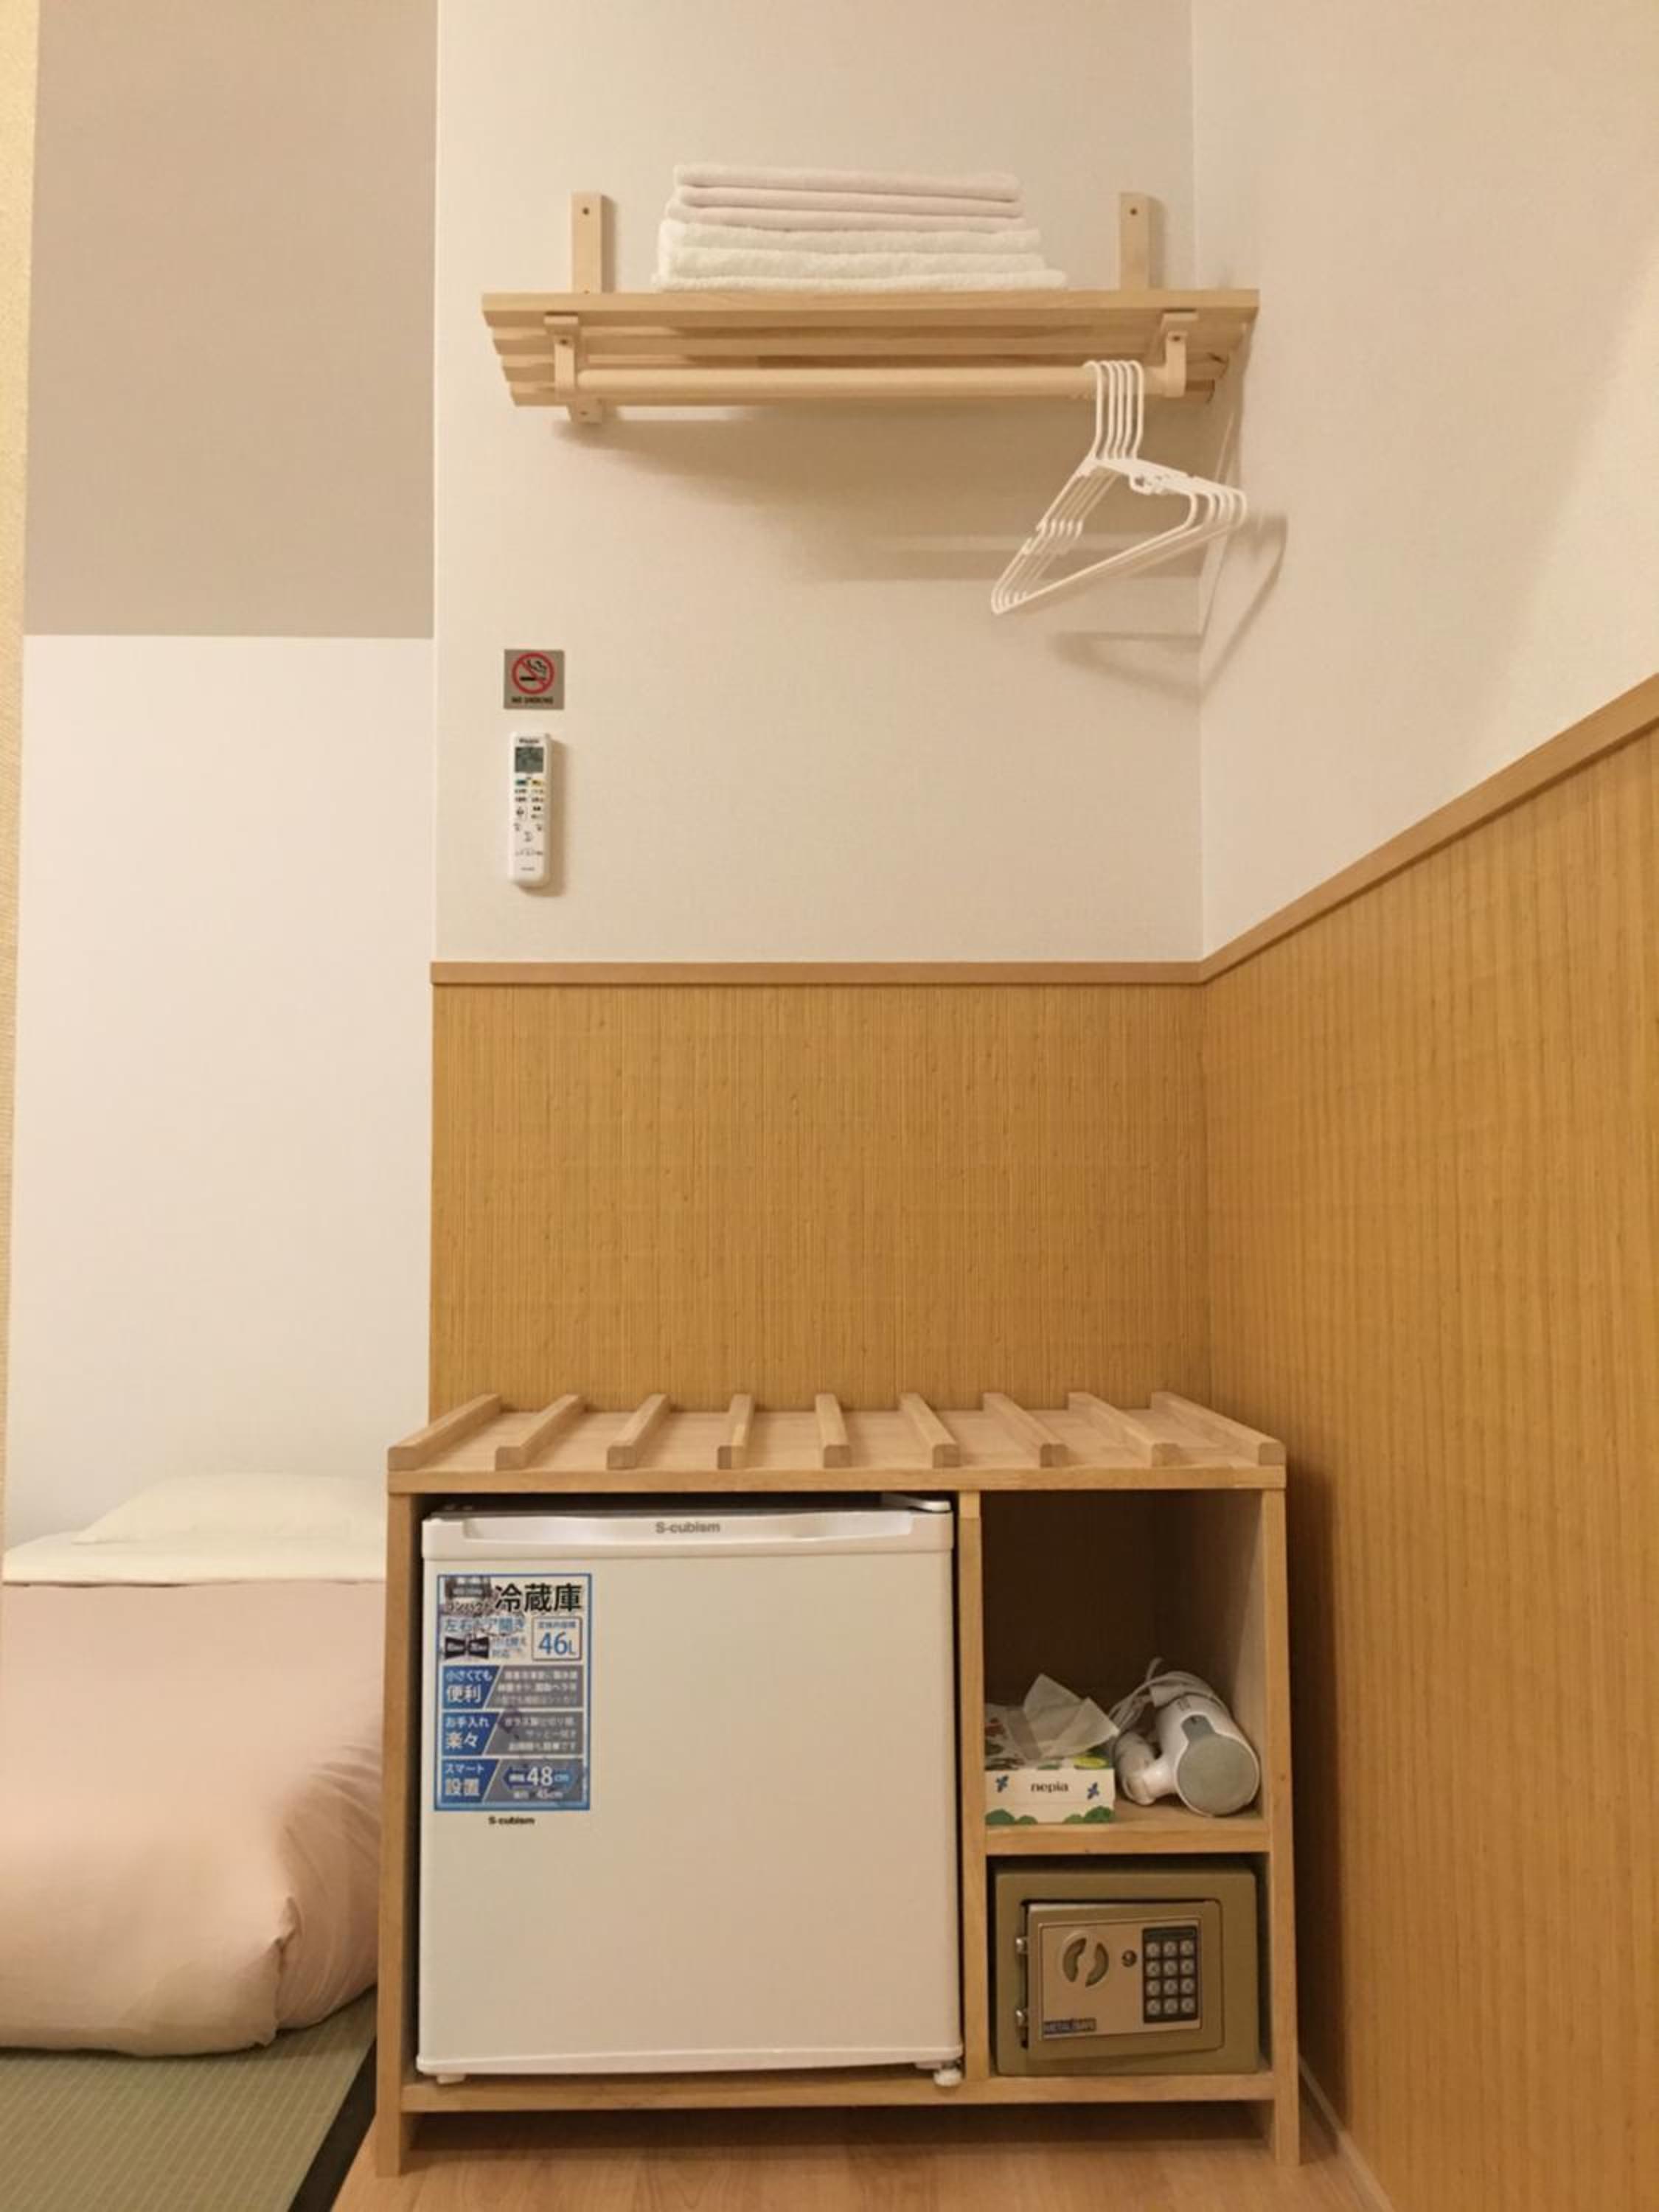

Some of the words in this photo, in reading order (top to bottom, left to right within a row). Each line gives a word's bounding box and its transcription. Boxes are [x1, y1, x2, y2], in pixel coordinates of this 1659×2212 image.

[655, 1521, 720, 1534] S-cubism
[495, 1582, 582, 1613] 冷蔵庫
[445, 1669, 493, 1682] 小さくても
[446, 1684, 482, 1703] 便利
[445, 1717, 490, 1729] お手入れ
[445, 1731, 479, 1750] 楽々
[445, 1763, 484, 1774] スマート
[445, 1778, 481, 1797] 設置
[1031, 1781, 1068, 1794] nepia
[488, 1816, 535, 1825] S-cubism
